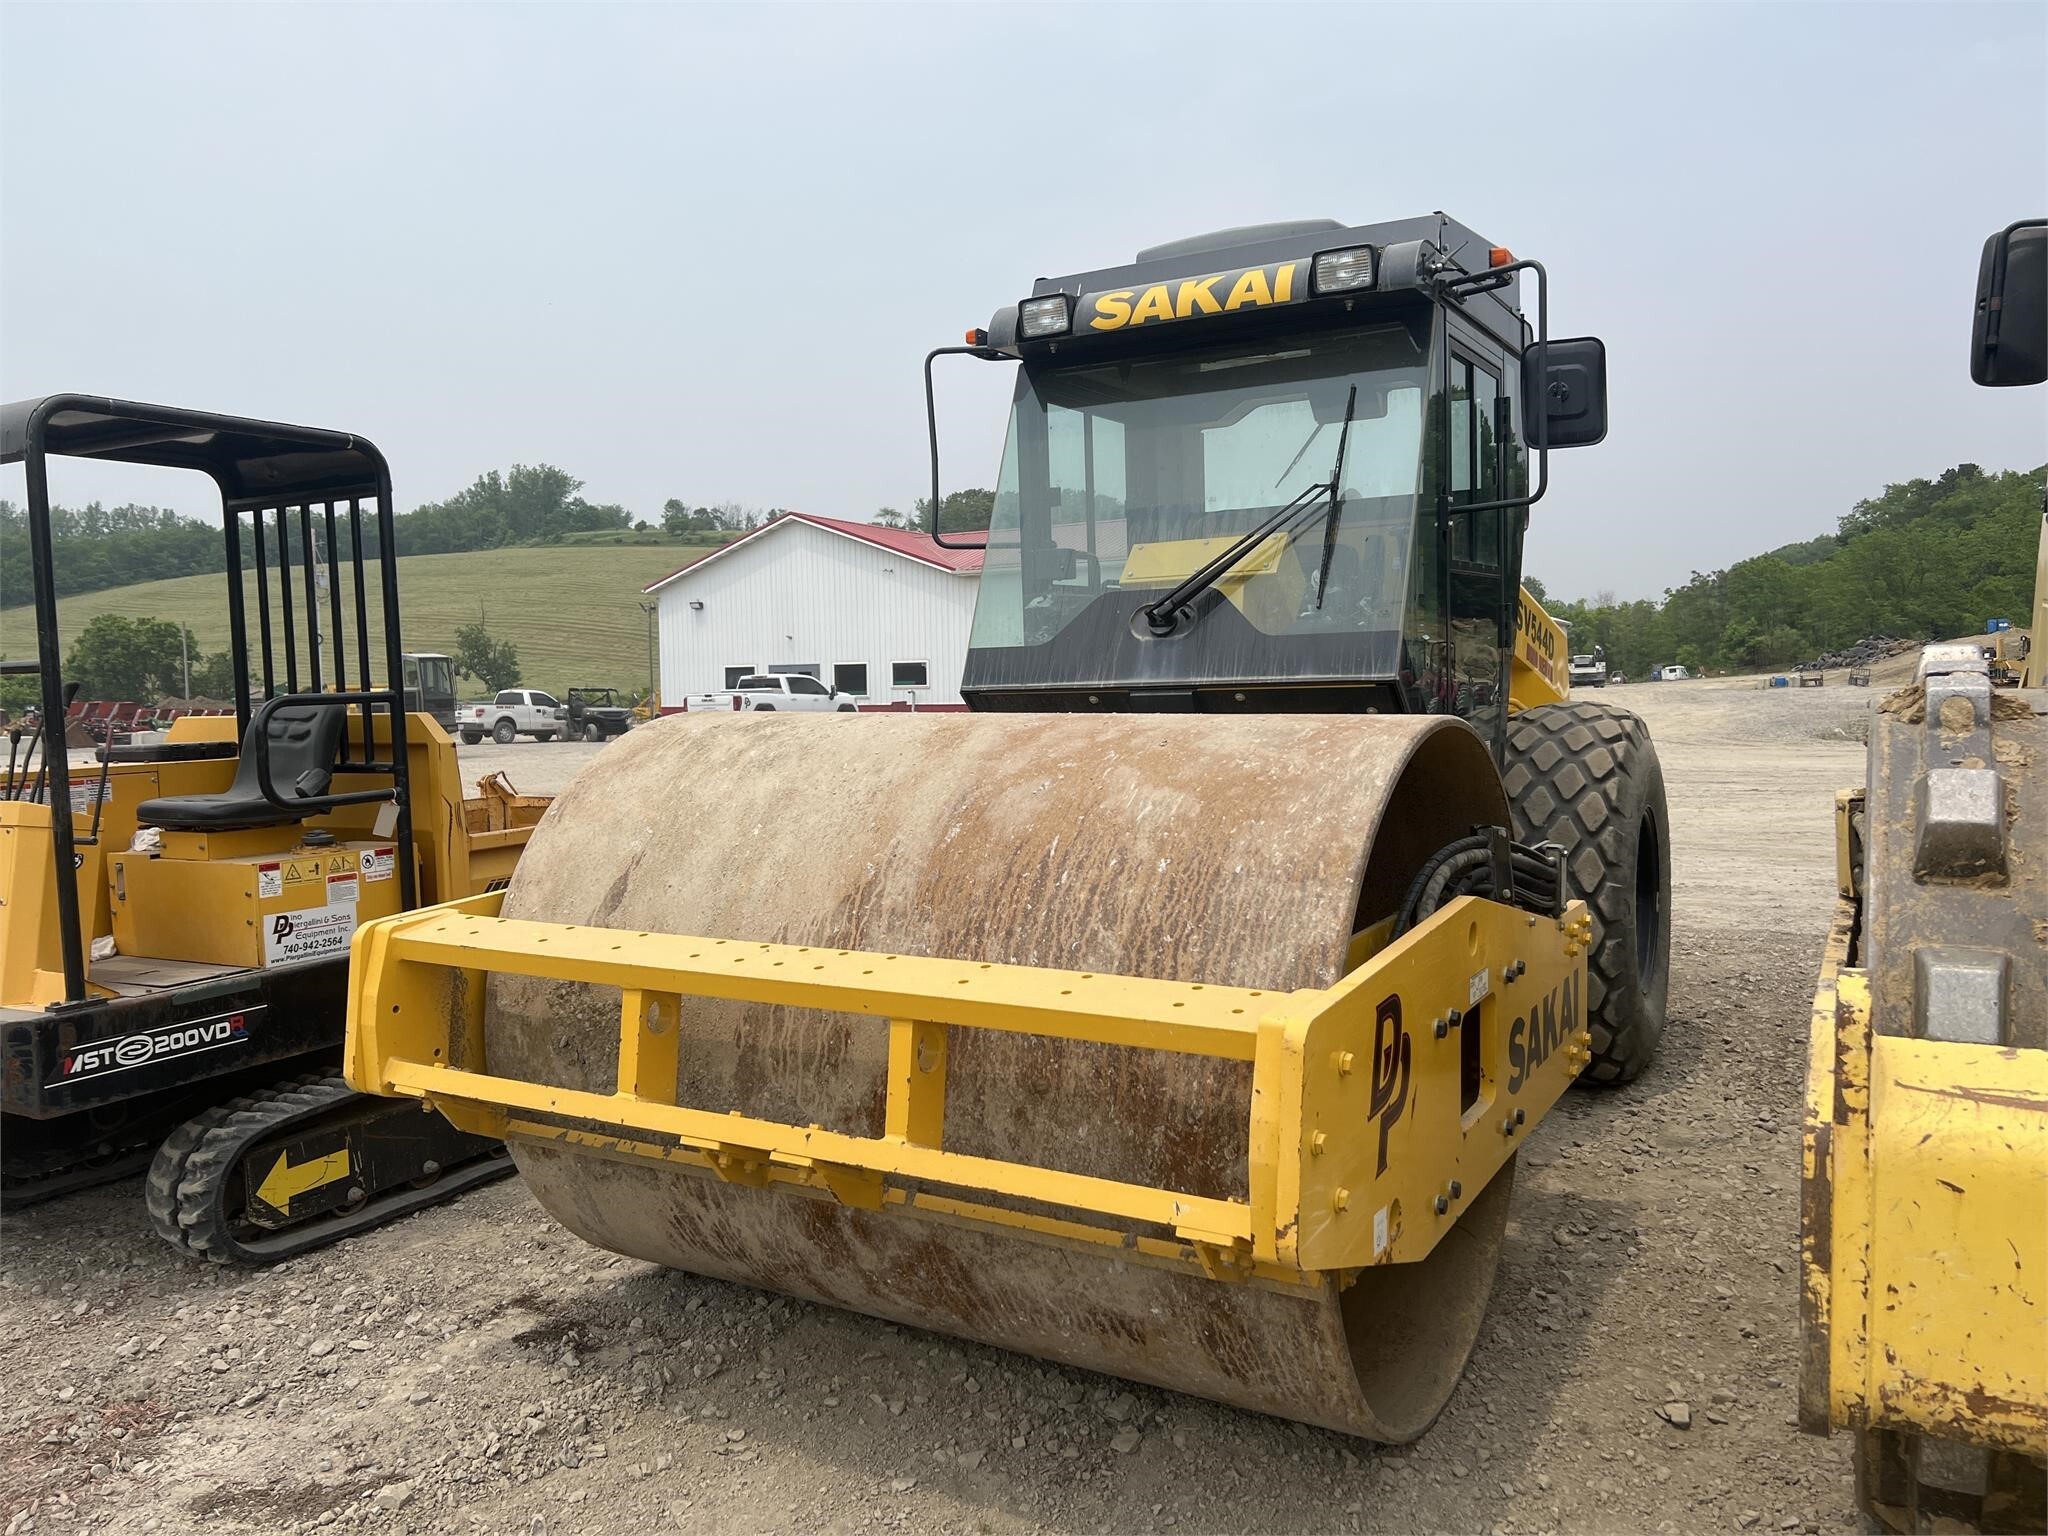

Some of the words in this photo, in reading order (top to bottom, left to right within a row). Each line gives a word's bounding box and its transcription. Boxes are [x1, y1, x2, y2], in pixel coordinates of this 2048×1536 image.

[1090, 263, 1297, 331] SAKAI
[1516, 599, 1555, 661] SV544D
[295, 927, 336, 940] Equipment
[331, 914, 352, 923] Sons
[283, 936, 343, 954] 740-942-2564
[1507, 968, 1580, 1095] SAKAI
